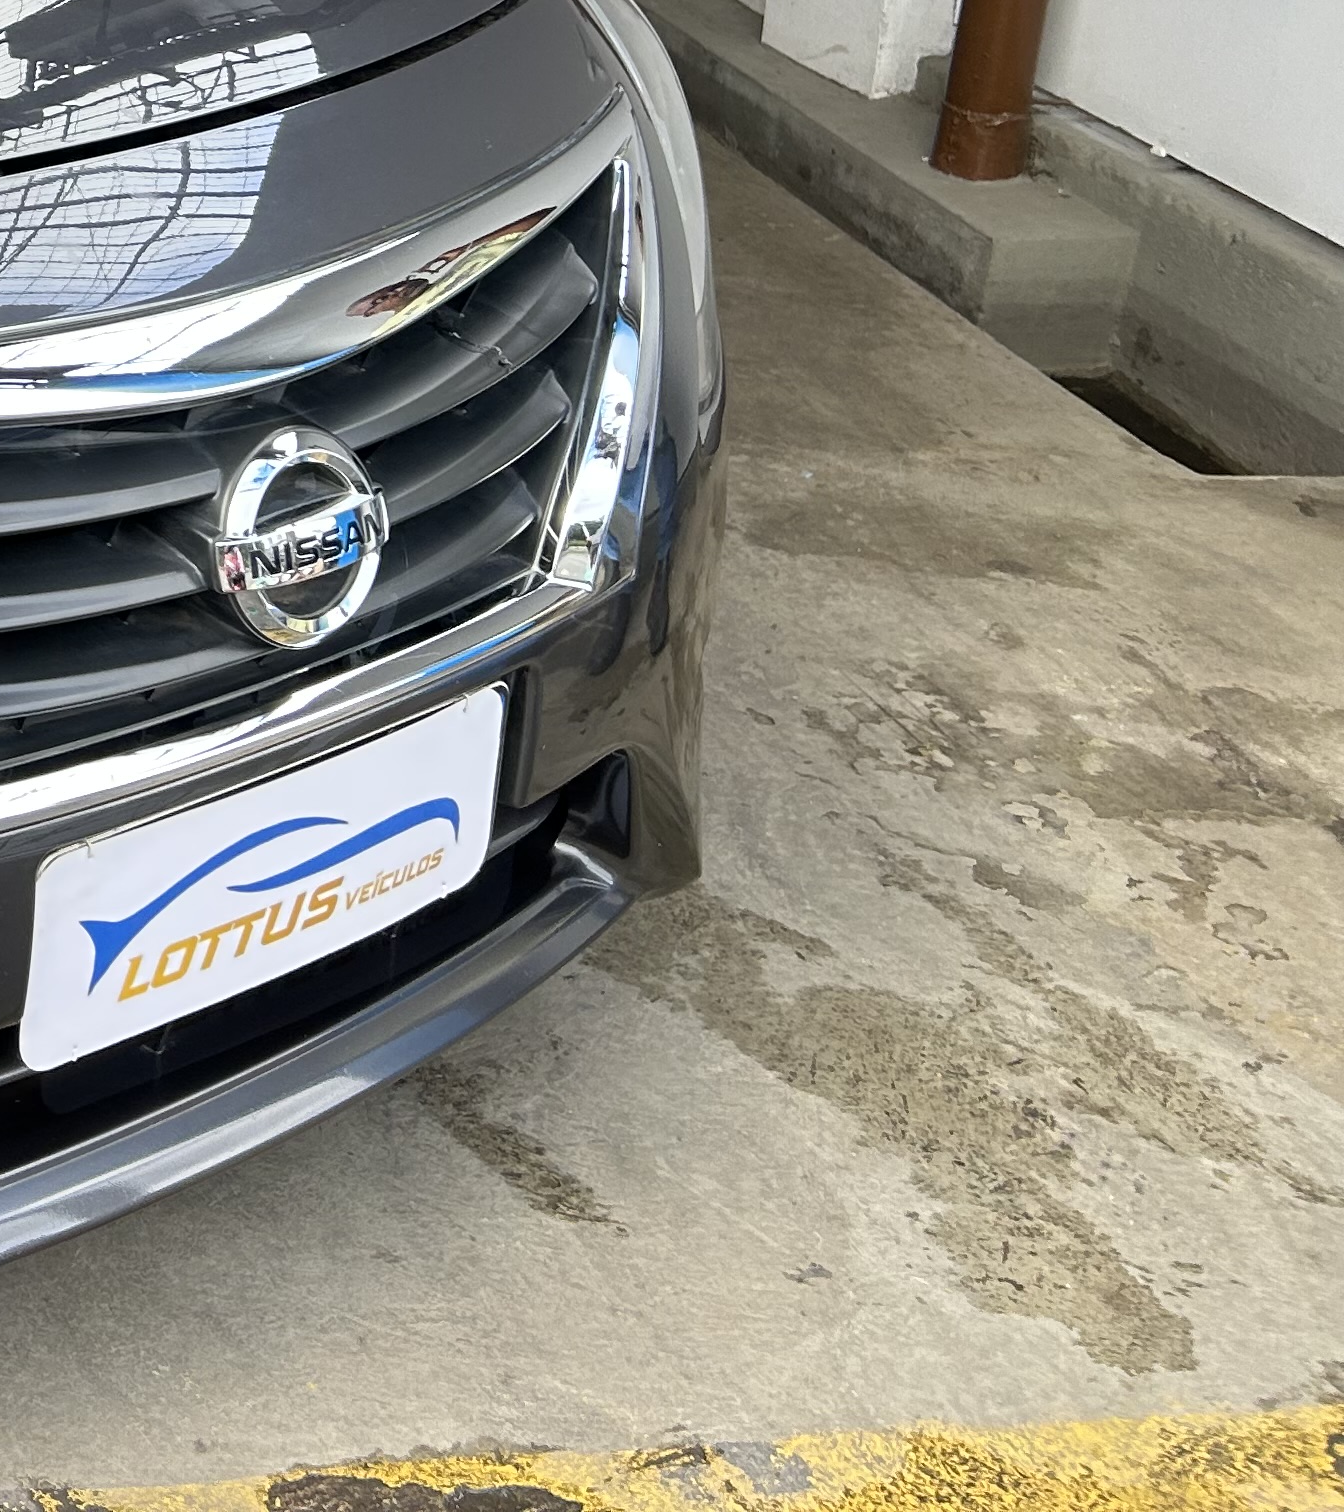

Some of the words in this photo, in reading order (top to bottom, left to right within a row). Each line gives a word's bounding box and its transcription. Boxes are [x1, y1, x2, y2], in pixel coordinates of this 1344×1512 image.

[249, 512, 384, 579] NISSAN
[117, 875, 345, 1002] LOTTUS
[344, 847, 444, 911] VEÍCULOS
